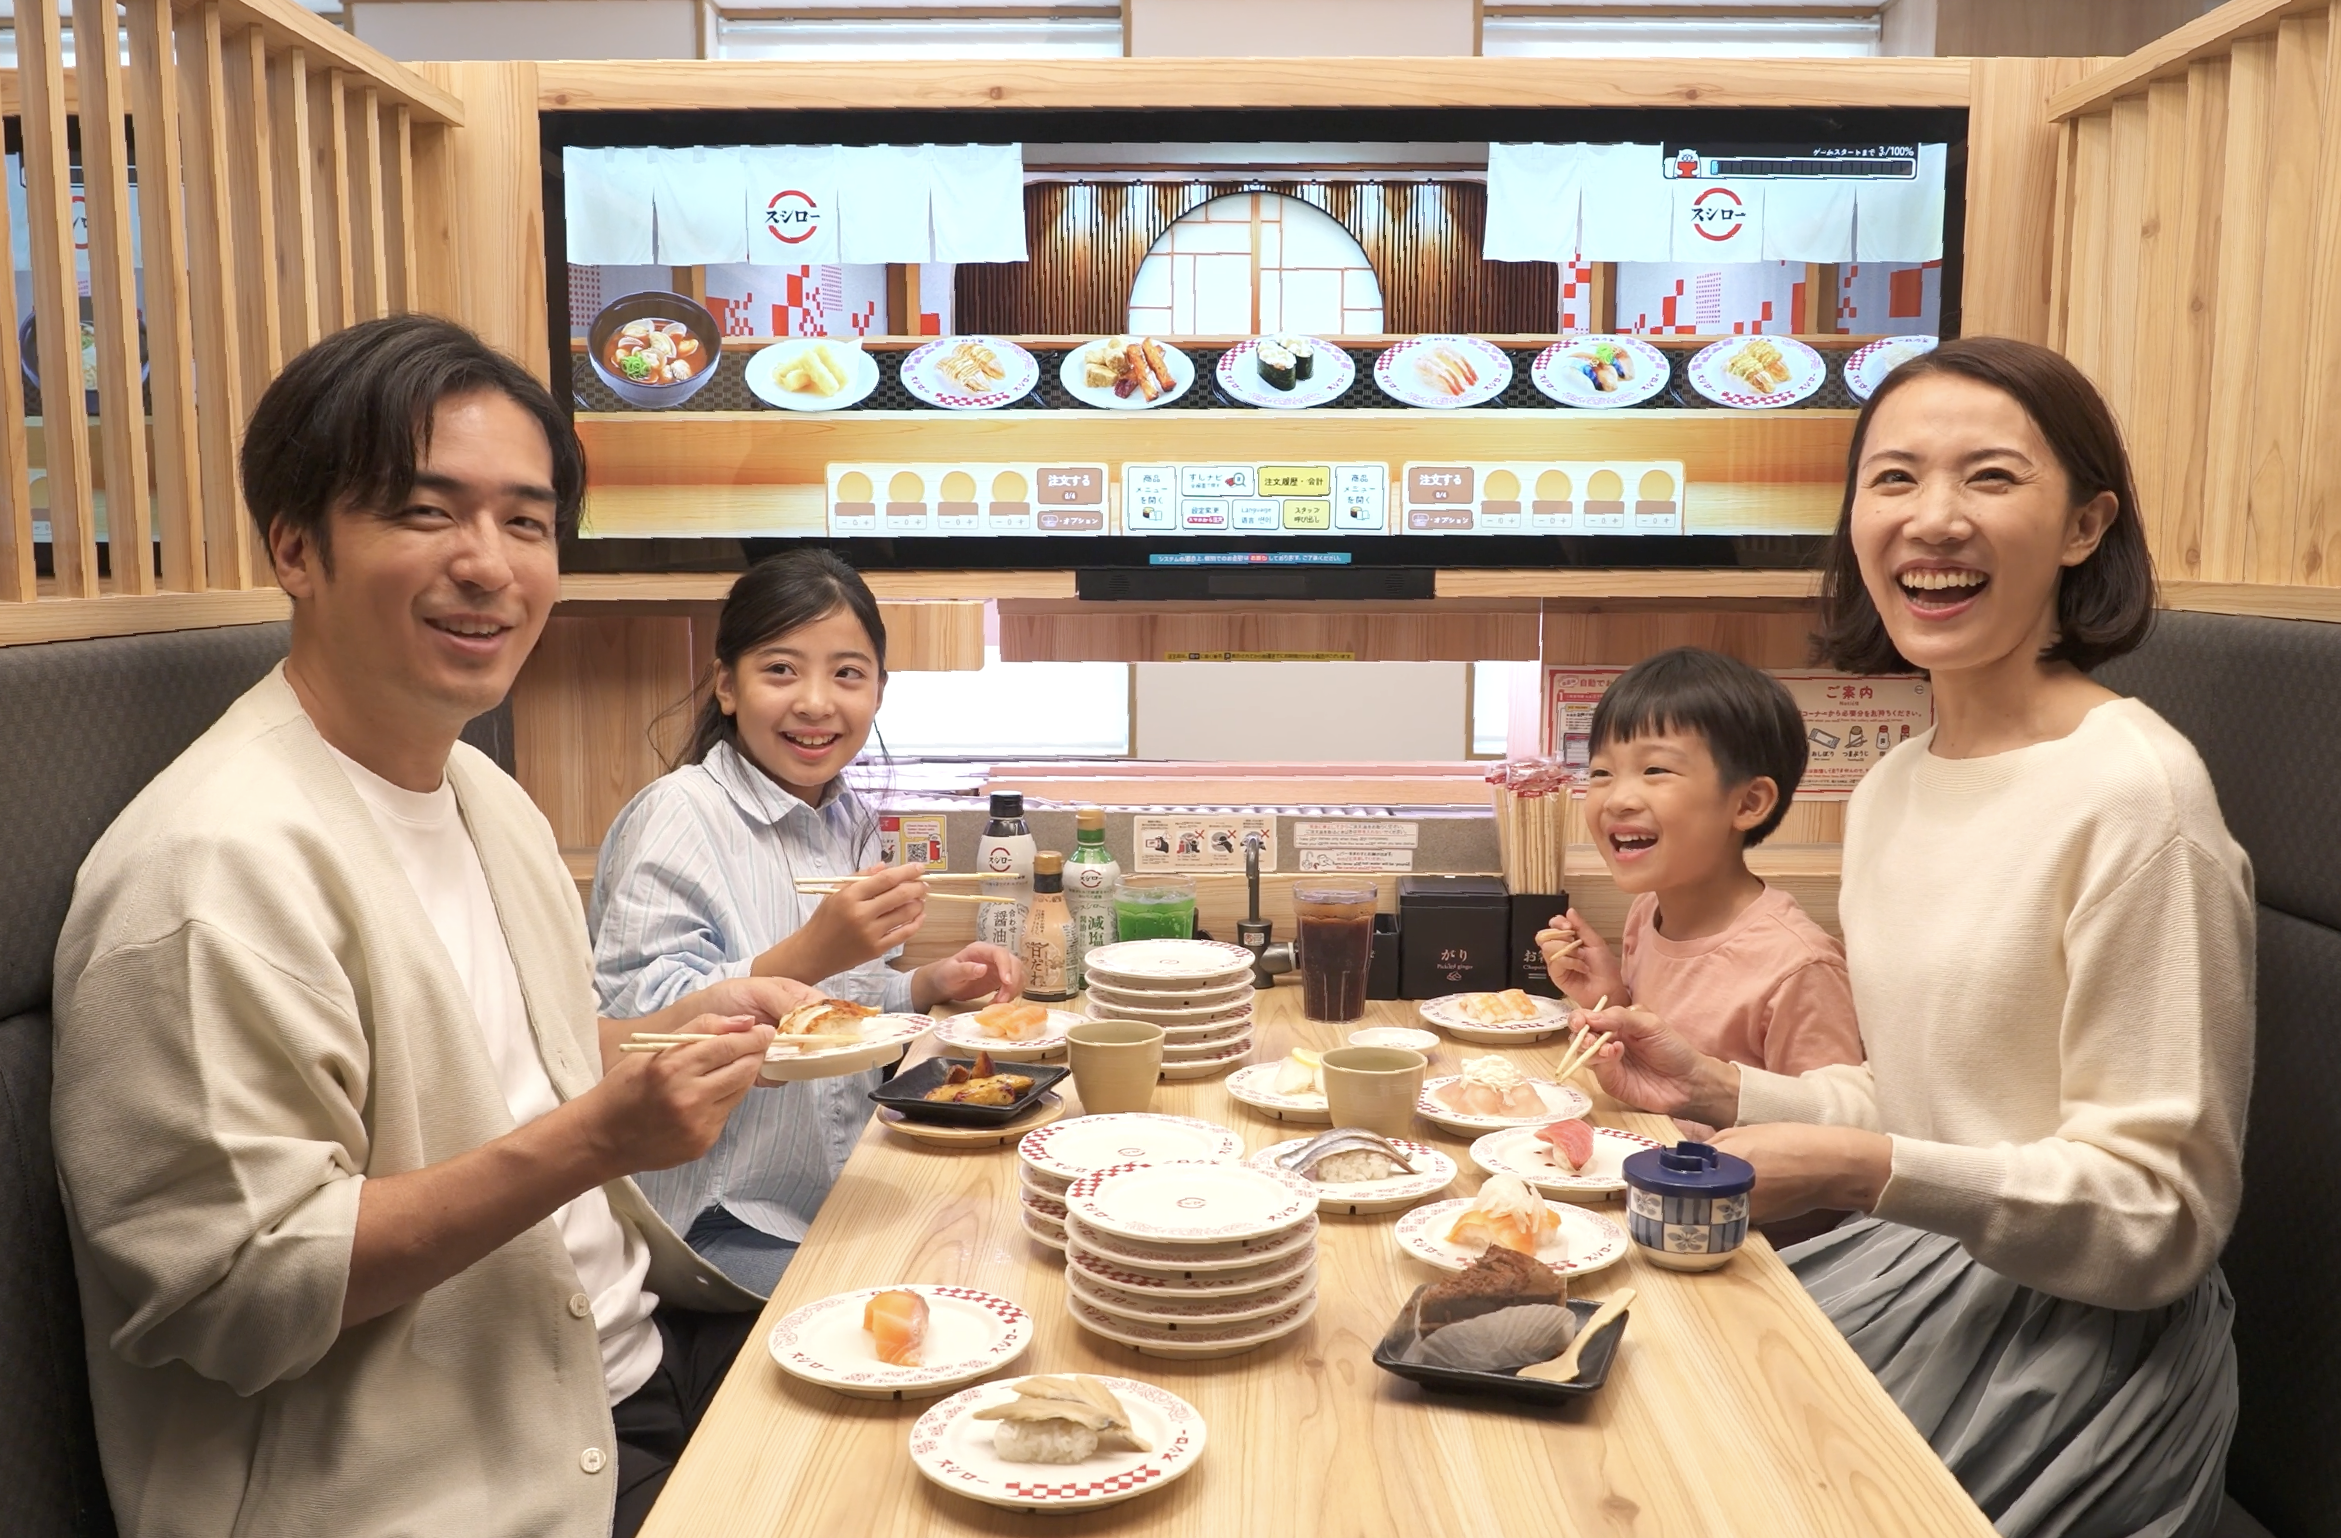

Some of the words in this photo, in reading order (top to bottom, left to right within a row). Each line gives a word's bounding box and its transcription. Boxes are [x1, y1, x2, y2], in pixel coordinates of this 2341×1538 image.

[765, 210, 820, 223] スシロー
[1691, 208, 1746, 221] スシロー
[1048, 474, 1090, 487] 注文する
[1419, 474, 1462, 486] 注文する
[1827, 685, 1873, 699] ご案内
[993, 911, 1008, 943] 醤油
[1009, 909, 1017, 934] 合わせ
[1088, 916, 1105, 946] 減塩
[1441, 949, 1467, 962] がり
[1267, 1201, 1300, 1221] スシロー
[1582, 1243, 1611, 1262] スシロー
[1267, 1303, 1300, 1327] スシロー
[990, 1329, 1018, 1354] スシロー
[787, 1351, 835, 1373] スシロー
[1161, 1429, 1188, 1463] スシロー
[935, 1458, 990, 1484] スシロー
